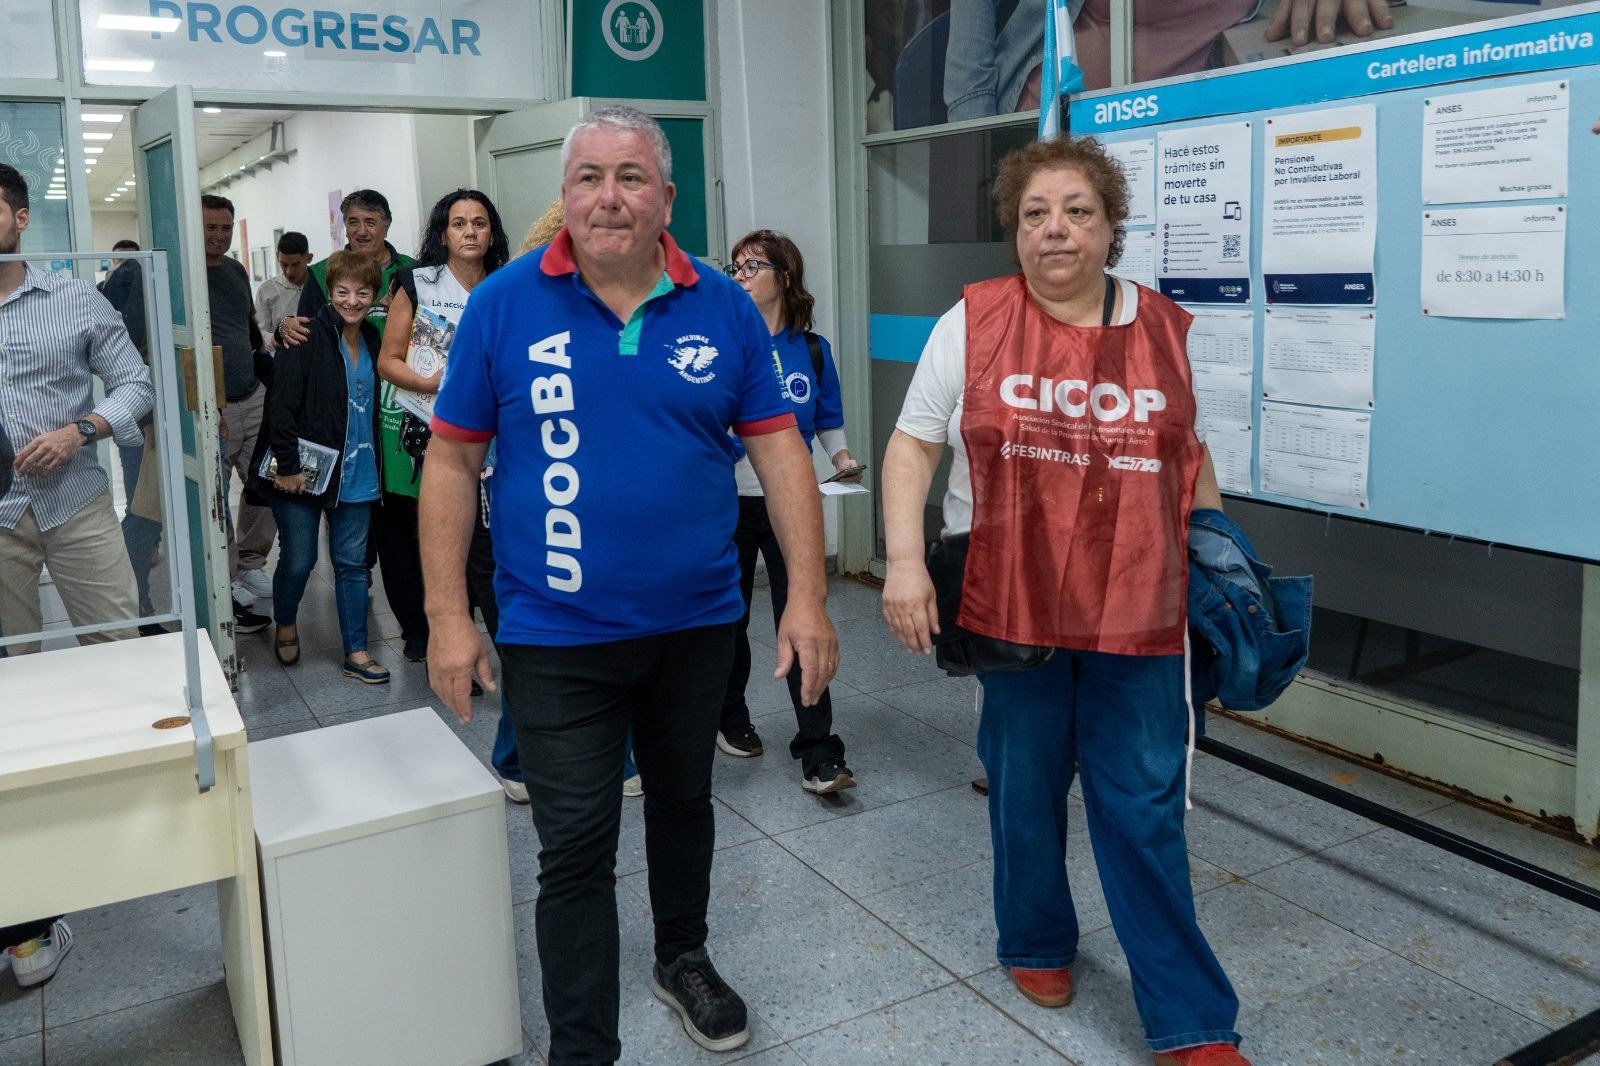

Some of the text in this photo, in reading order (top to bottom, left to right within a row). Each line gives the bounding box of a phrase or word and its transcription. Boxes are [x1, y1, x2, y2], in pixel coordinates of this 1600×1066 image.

[150, 0, 482, 56] PROGRESAR
[1367, 31, 1594, 80] Cartelera informativa
[1094, 95, 1158, 124] anses
[1436, 94, 1557, 114] ANSES informa
[1278, 134, 1322, 144] IMPORTANTE
[1164, 144, 1219, 158] Hacé estos
[1164, 158, 1224, 174] trámites sin
[1275, 155, 1315, 165] Pensiones
[1288, 162, 1343, 174] Contributivas
[1164, 178, 1207, 189] moverte
[1274, 170, 1360, 187] por Invalidez Laboral
[1164, 194, 1216, 205] de tu casa
[1430, 218, 1456, 227] ANSES
[1437, 269, 1544, 282] de 8:30 a 14:30 h
[676, 334, 709, 344] MALVINAS
[1000, 374, 1167, 423] CICOP
[1013, 414, 1050, 424] Asociación
[1052, 419, 1077, 429] Sindical
[1020, 424, 1040, 432] Salud
[528, 330, 583, 593] UDOCBA
[1012, 444, 1091, 466] FESINTRAS
